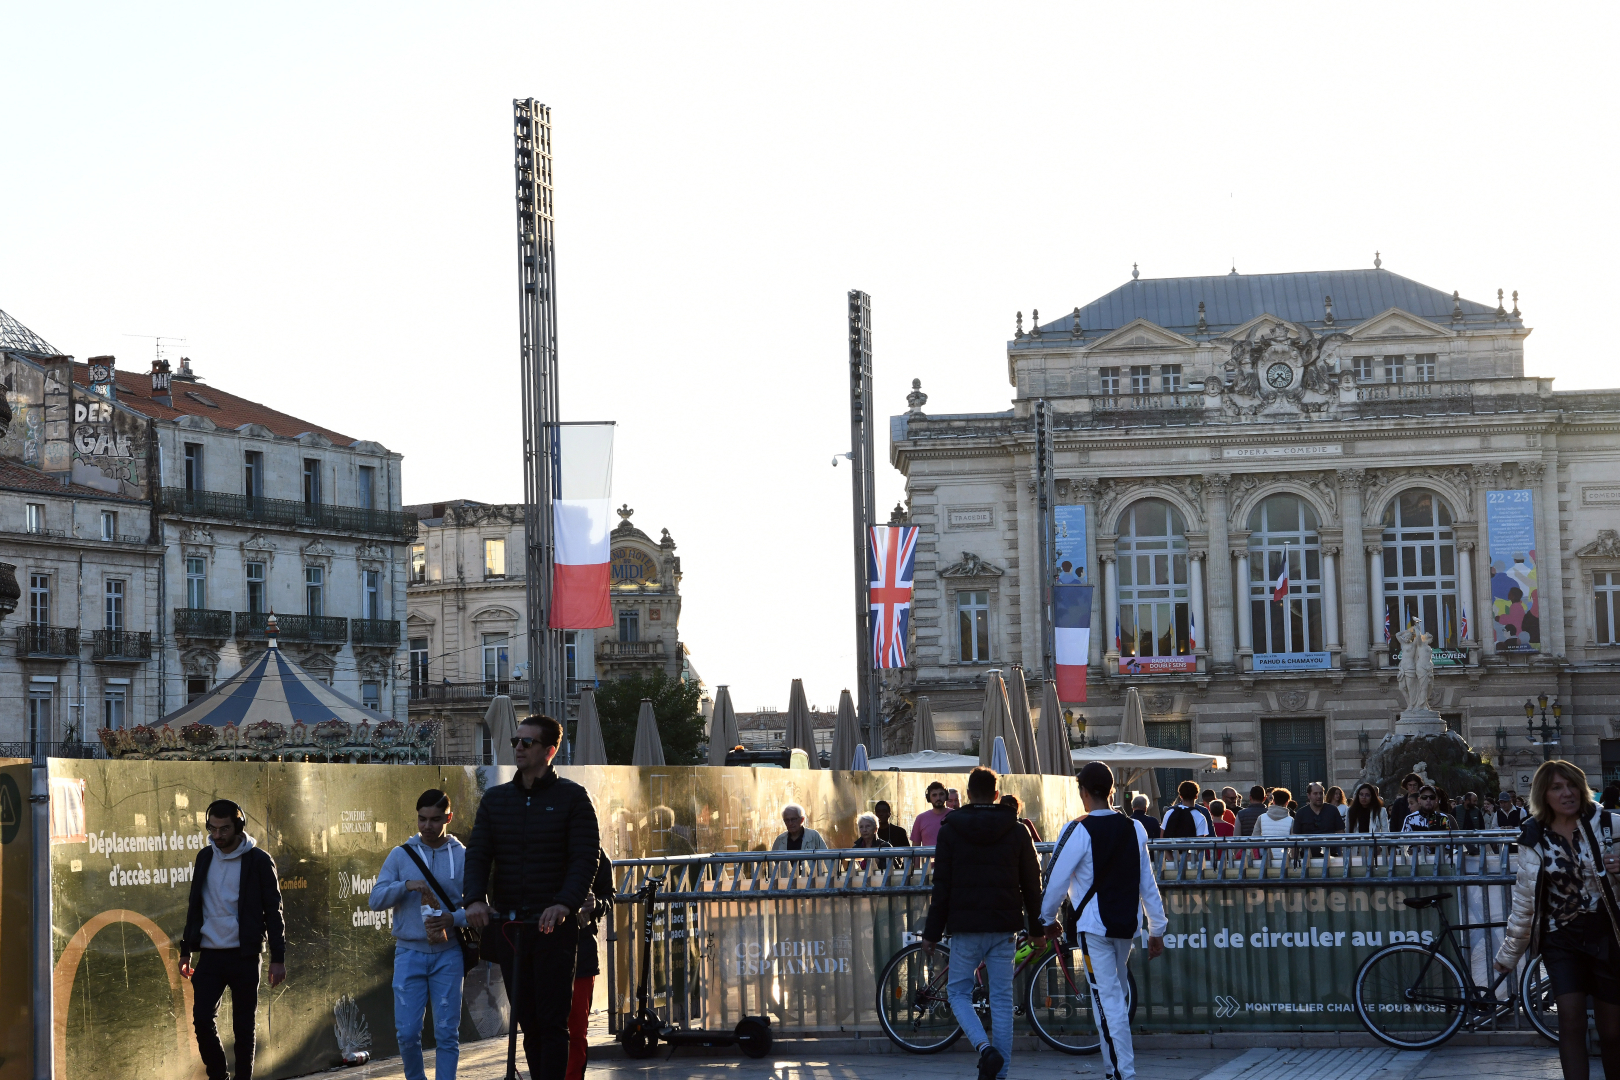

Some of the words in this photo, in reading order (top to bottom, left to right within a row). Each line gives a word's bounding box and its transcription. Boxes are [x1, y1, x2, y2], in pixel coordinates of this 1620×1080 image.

[74, 402, 114, 424] DER
[1237, 446, 1269, 456] OPERA
[1283, 446, 1328, 454] COMEDIE
[1489, 493, 1505, 503] 22
[1513, 491, 1529, 502] 23
[612, 564, 643, 579] MIDI
[88, 829, 168, 859] Déplacement
[169, 830, 184, 851] de
[186, 830, 204, 850] cet
[109, 862, 151, 887] d'accès
[153, 868, 168, 884] au
[352, 905, 387, 931] change
[645, 912, 653, 943] PURE
[1213, 927, 1245, 949] de
[1250, 926, 1345, 948] circuler
[1351, 930, 1383, 947] au
[735, 938, 826, 959] COMÉDIE
[735, 957, 851, 976] ESPLANADE
[1245, 1002, 1324, 1012] MONTPELLIER
[1378, 1003, 1411, 1013] POUR
